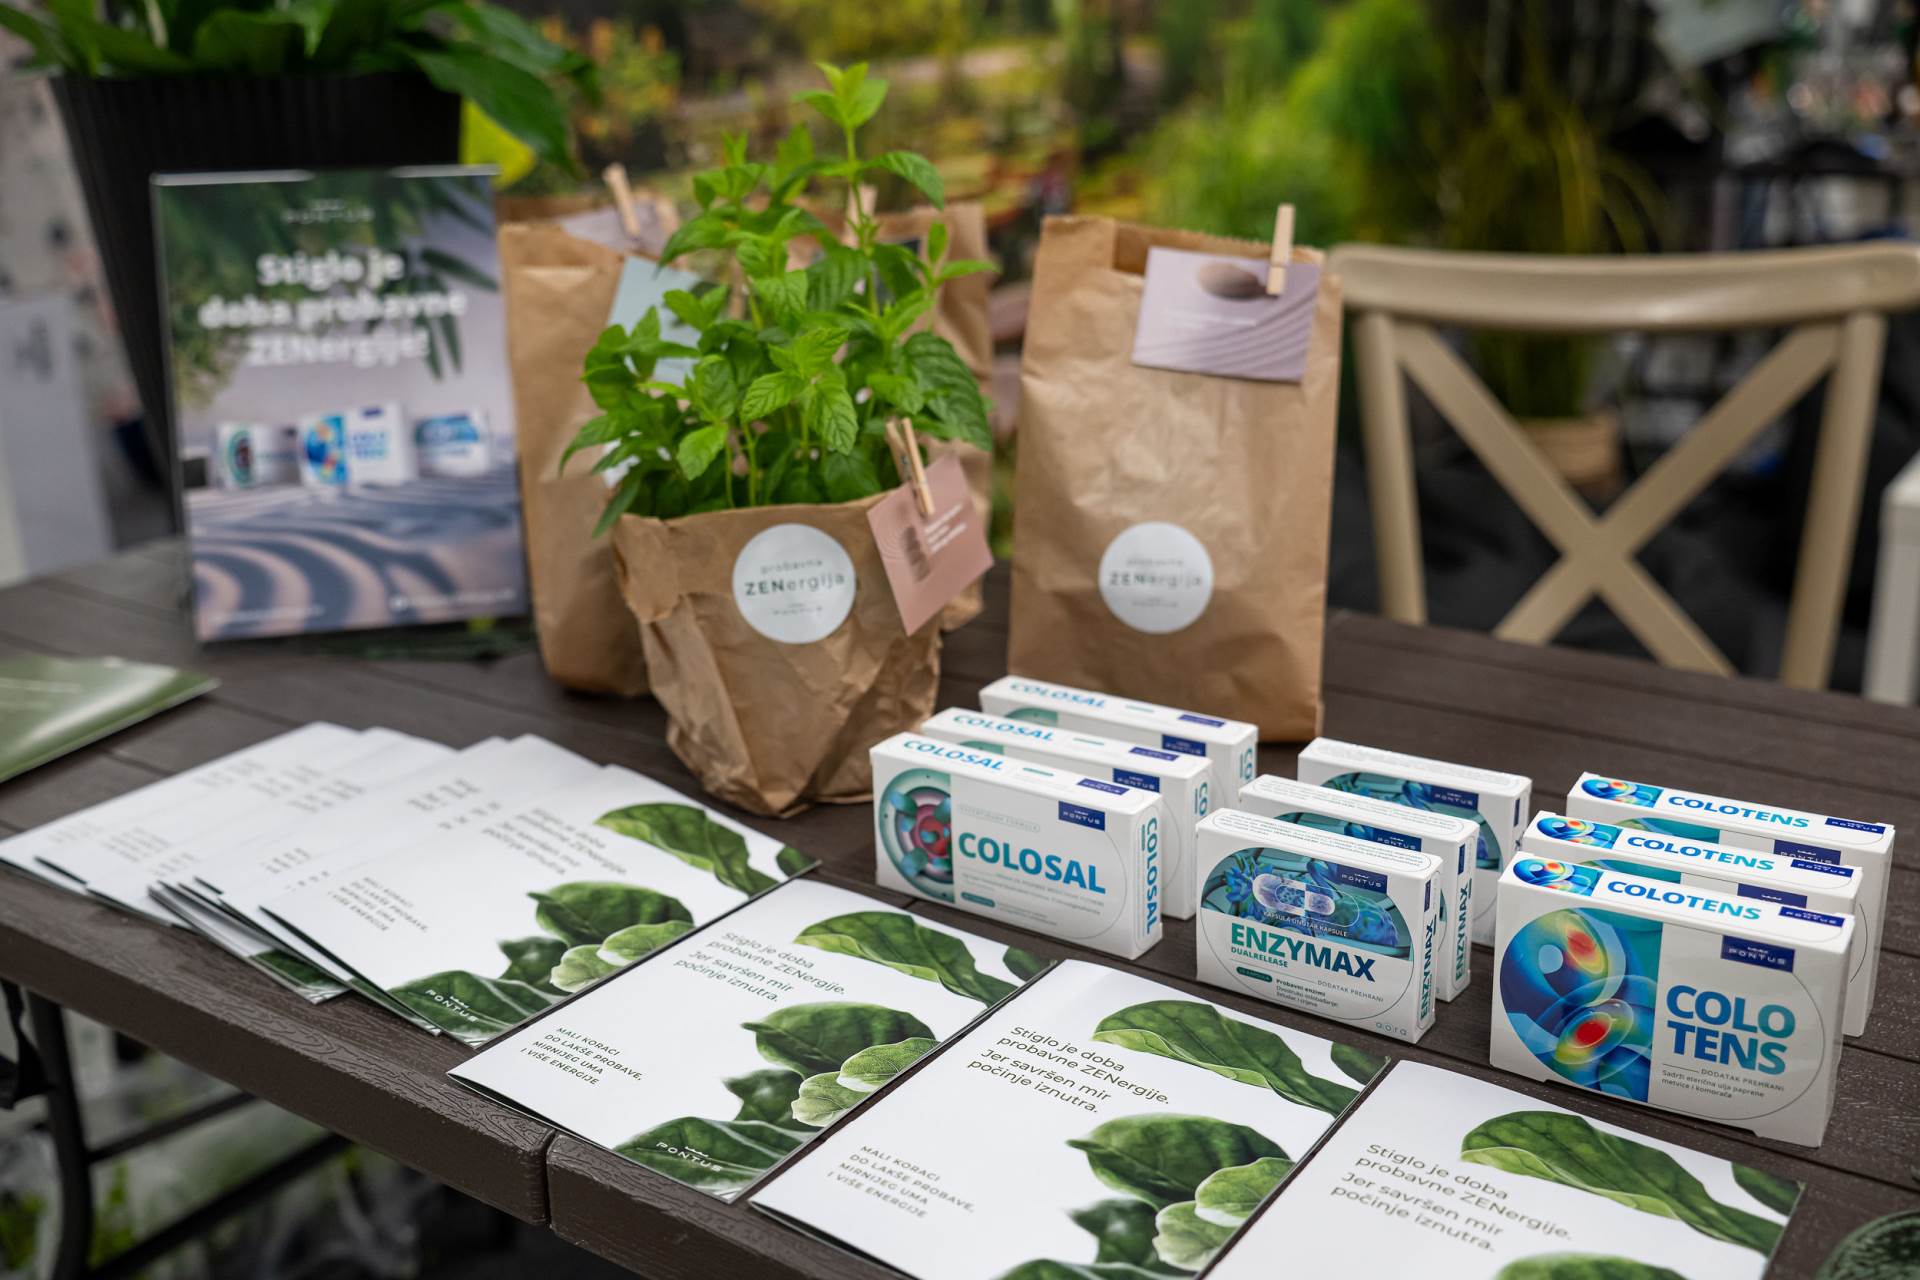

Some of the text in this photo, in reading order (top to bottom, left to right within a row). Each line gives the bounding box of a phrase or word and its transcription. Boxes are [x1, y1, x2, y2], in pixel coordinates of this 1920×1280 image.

[257, 247, 404, 291] Stiglo je
[198, 288, 467, 331] doba probavne
[744, 572, 845, 596] ZENergija
[1010, 683, 1106, 708] COLOSAL
[953, 714, 1055, 742] COLOSAL
[903, 739, 1005, 771] COLOSAL
[1434, 792, 1474, 806] PONTUS
[1668, 796, 1810, 828] COLOTENS
[1062, 811, 1101, 825] PONTUS
[1377, 836, 1417, 850] PONTUS
[1627, 836, 1776, 872] COLOTENS
[958, 832, 1106, 894] COLOSAL
[1146, 817, 1158, 934] COLOSAL
[1341, 872, 1382, 888] PONTUS
[1607, 880, 1762, 921] COLOTENS
[1785, 911, 1838, 925] PONTUS
[721, 932, 815, 969] Stiglo je doba
[1455, 882, 1469, 982] ENZYMAX
[706, 940, 846, 995] probavne ZENergije.
[1231, 922, 1376, 982] ENZYMAX
[1231, 947, 1289, 968] DUALRELEASE
[1420, 918, 1434, 1021] ENZYMAX
[1728, 947, 1787, 966] PONTUS
[673, 959, 778, 1002] počinje iznutra.
[689, 951, 795, 992] Jer savršen mir
[425, 989, 479, 1023] PONTUS
[1317, 980, 1349, 993] DODATAK
[1350, 989, 1384, 1003] PREHRANI
[1666, 985, 1796, 1039] COLO
[544, 1034, 561, 1042] DO
[556, 1027, 621, 1056] MALI KORACI
[1010, 1026, 1125, 1072] Stiglo je doba
[1667, 1020, 1788, 1075] TENS
[532, 1040, 604, 1075] MIRNIJEG UMA
[550, 1059, 600, 1085] ENERGIJE
[980, 1049, 1112, 1101] Jer savršen mir
[996, 1036, 1170, 1104] probavne ZENergije.
[967, 1059, 1099, 1113] počinje iznutra.
[1701, 1068, 1785, 1092] DODATAK PREHRANI
[656, 1142, 723, 1172] PONTUS
[849, 1154, 869, 1165] DO
[860, 1145, 942, 1182] MALI KORACI
[1366, 1143, 1509, 1200] Stiglo je doba
[838, 1162, 928, 1205] MIRNIJEG UMA
[865, 1186, 928, 1218] ENERGIJE
[1354, 1156, 1573, 1240] probavne ZENergije.
[1330, 1185, 1496, 1252] počinje iznutra.
[1341, 1172, 1504, 1236] Jer savršen mir
